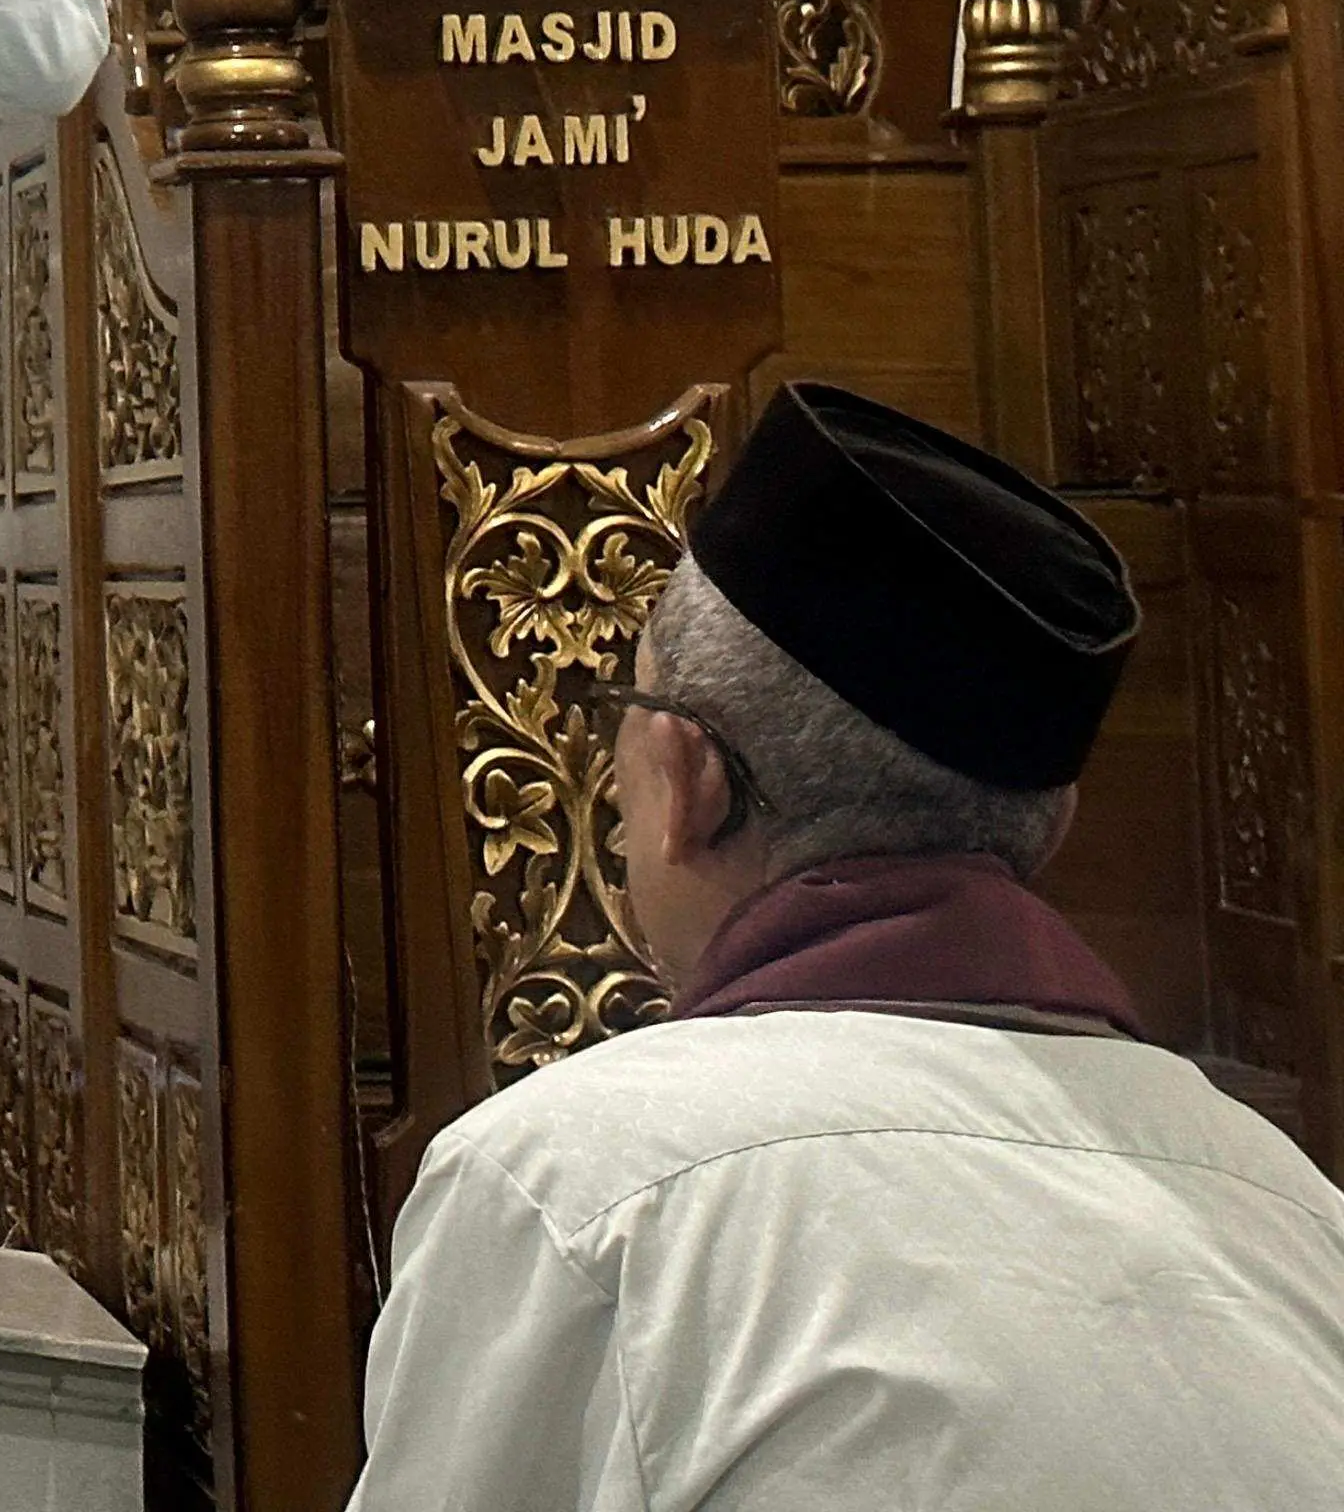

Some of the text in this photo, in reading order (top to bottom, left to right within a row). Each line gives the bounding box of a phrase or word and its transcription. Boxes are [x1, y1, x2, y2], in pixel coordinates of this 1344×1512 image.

[440, 10, 677, 64] MASJID
[476, 94, 647, 168] JAMI'
[360, 214, 773, 273] NURUL HUDA
